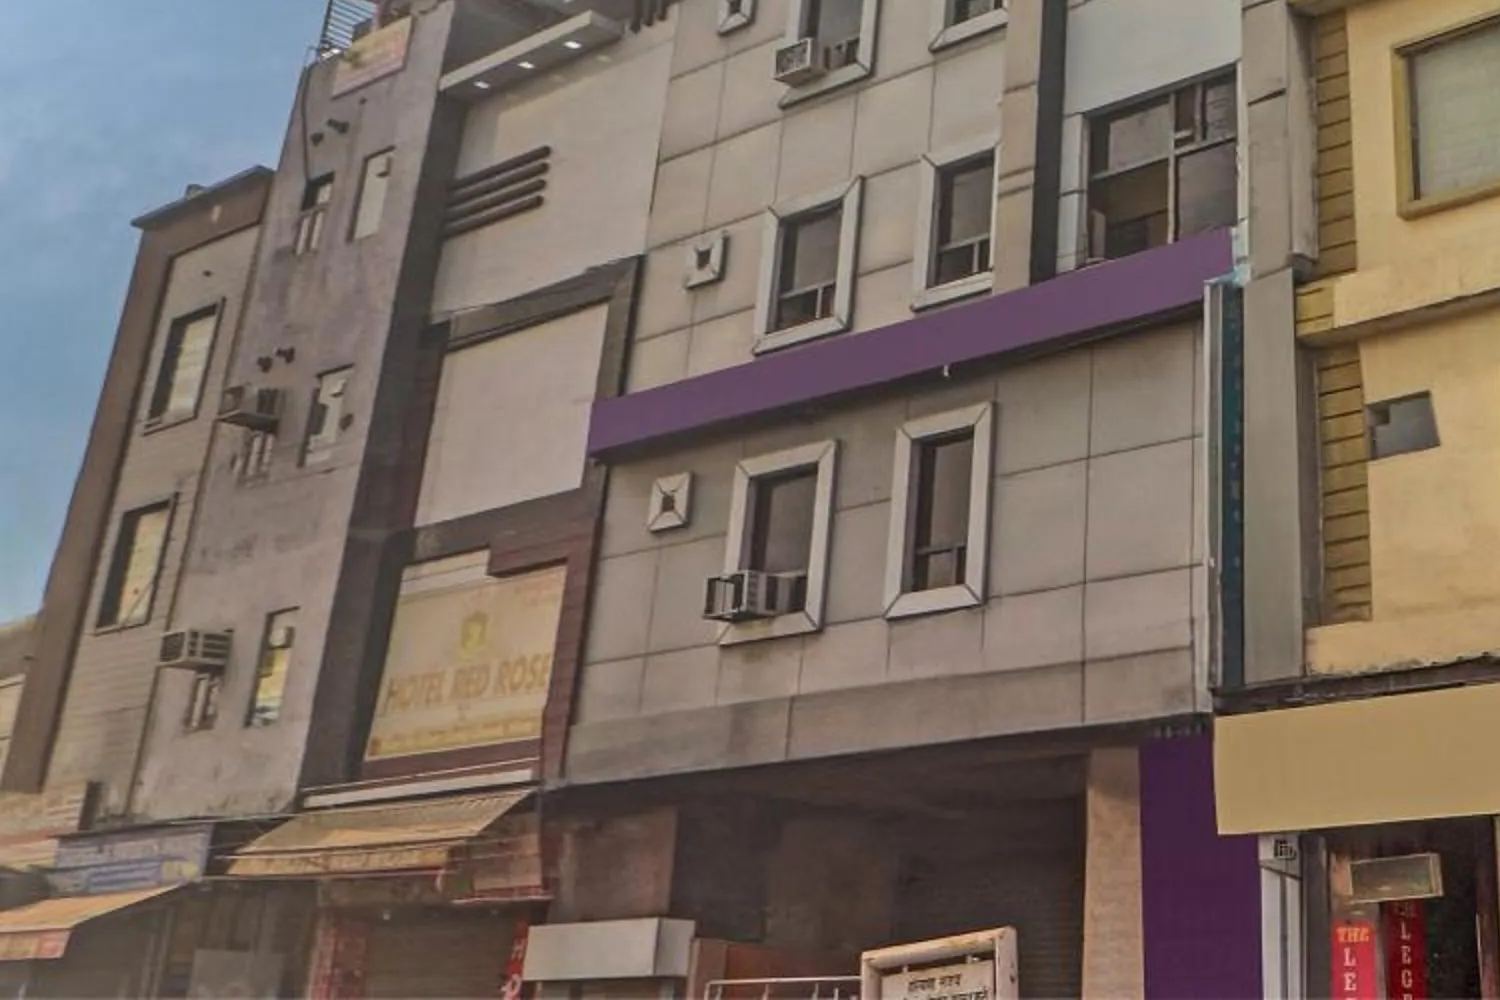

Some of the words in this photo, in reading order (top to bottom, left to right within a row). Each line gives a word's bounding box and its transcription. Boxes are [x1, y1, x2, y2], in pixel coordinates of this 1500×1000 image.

[382, 671, 446, 713] HOTEL
[453, 662, 490, 699] RED
[1335, 926, 1370, 943] THE
[1343, 946, 1357, 1000] LE
